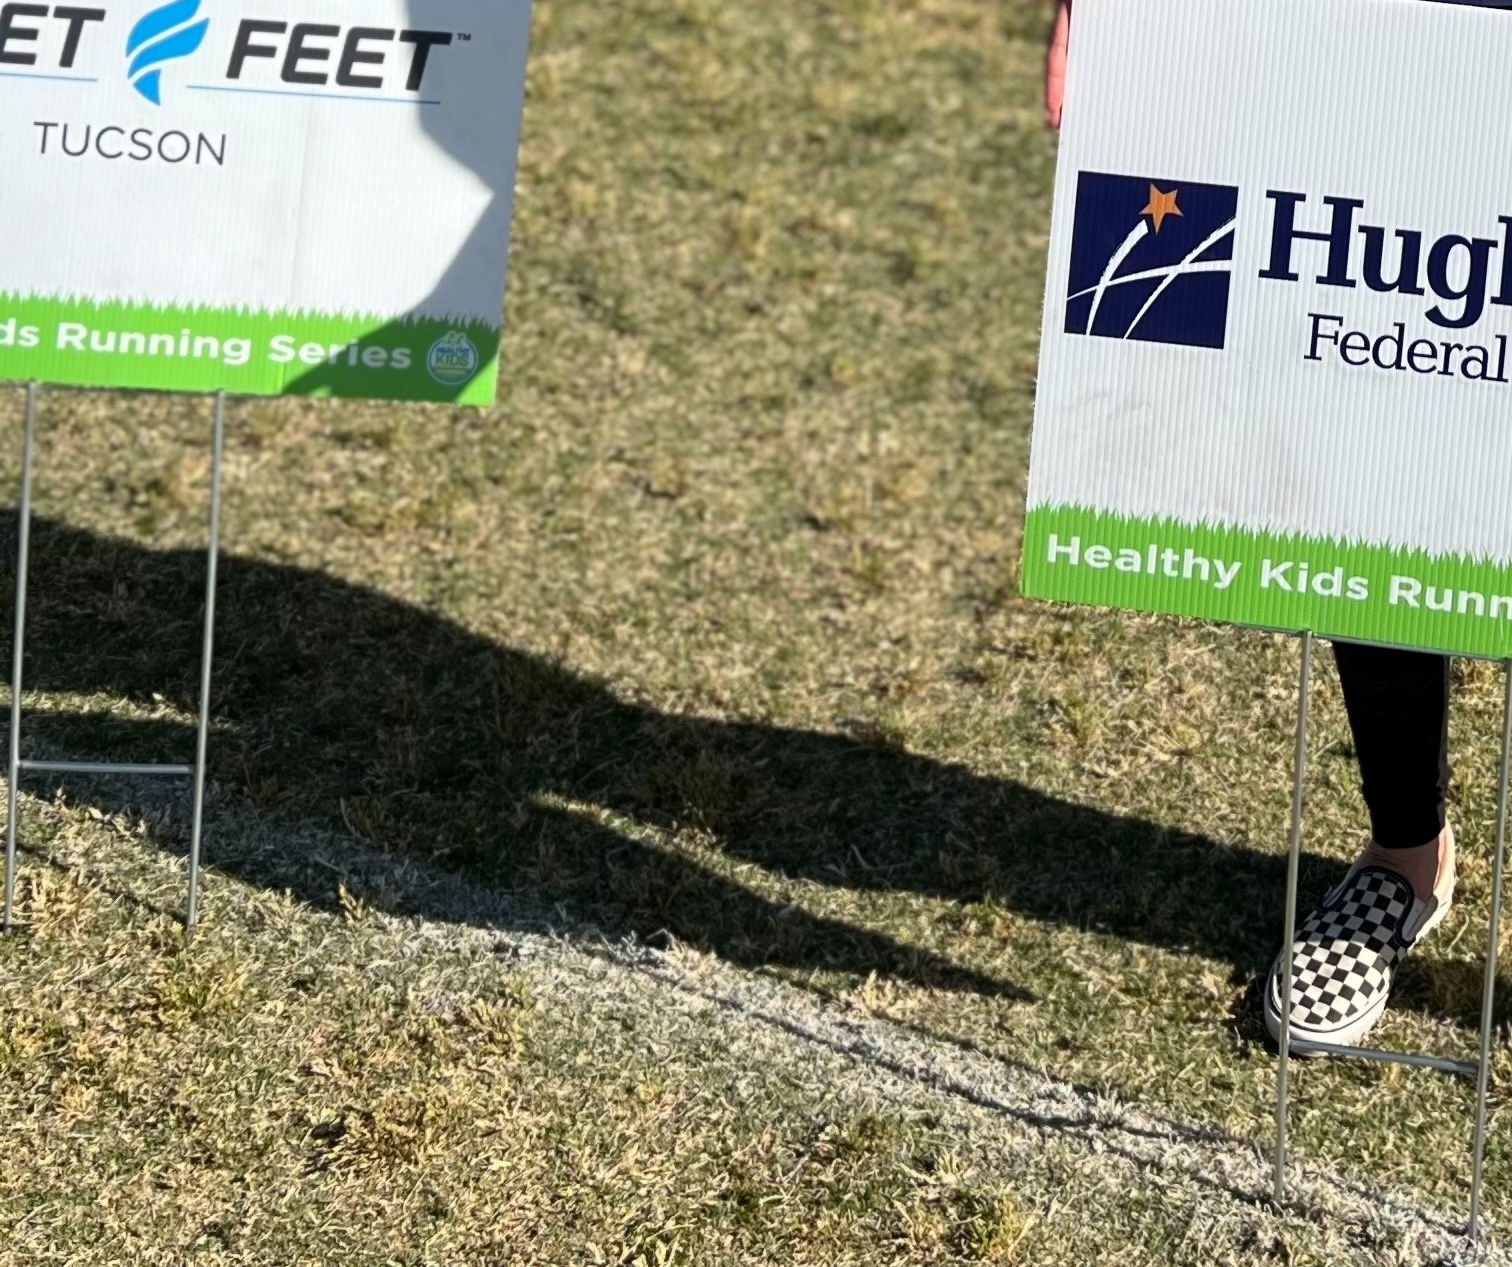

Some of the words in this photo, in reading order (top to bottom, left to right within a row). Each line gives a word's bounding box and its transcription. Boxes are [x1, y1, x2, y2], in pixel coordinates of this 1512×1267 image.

[226, 18, 453, 91] FEET
[33, 121, 227, 166] TUCSON
[56, 321, 252, 366] Running
[267, 334, 412, 369] Series
[1303, 313, 1509, 383] Federal
[1046, 533, 1242, 590] Healthy
[1260, 559, 1369, 601] Kids
